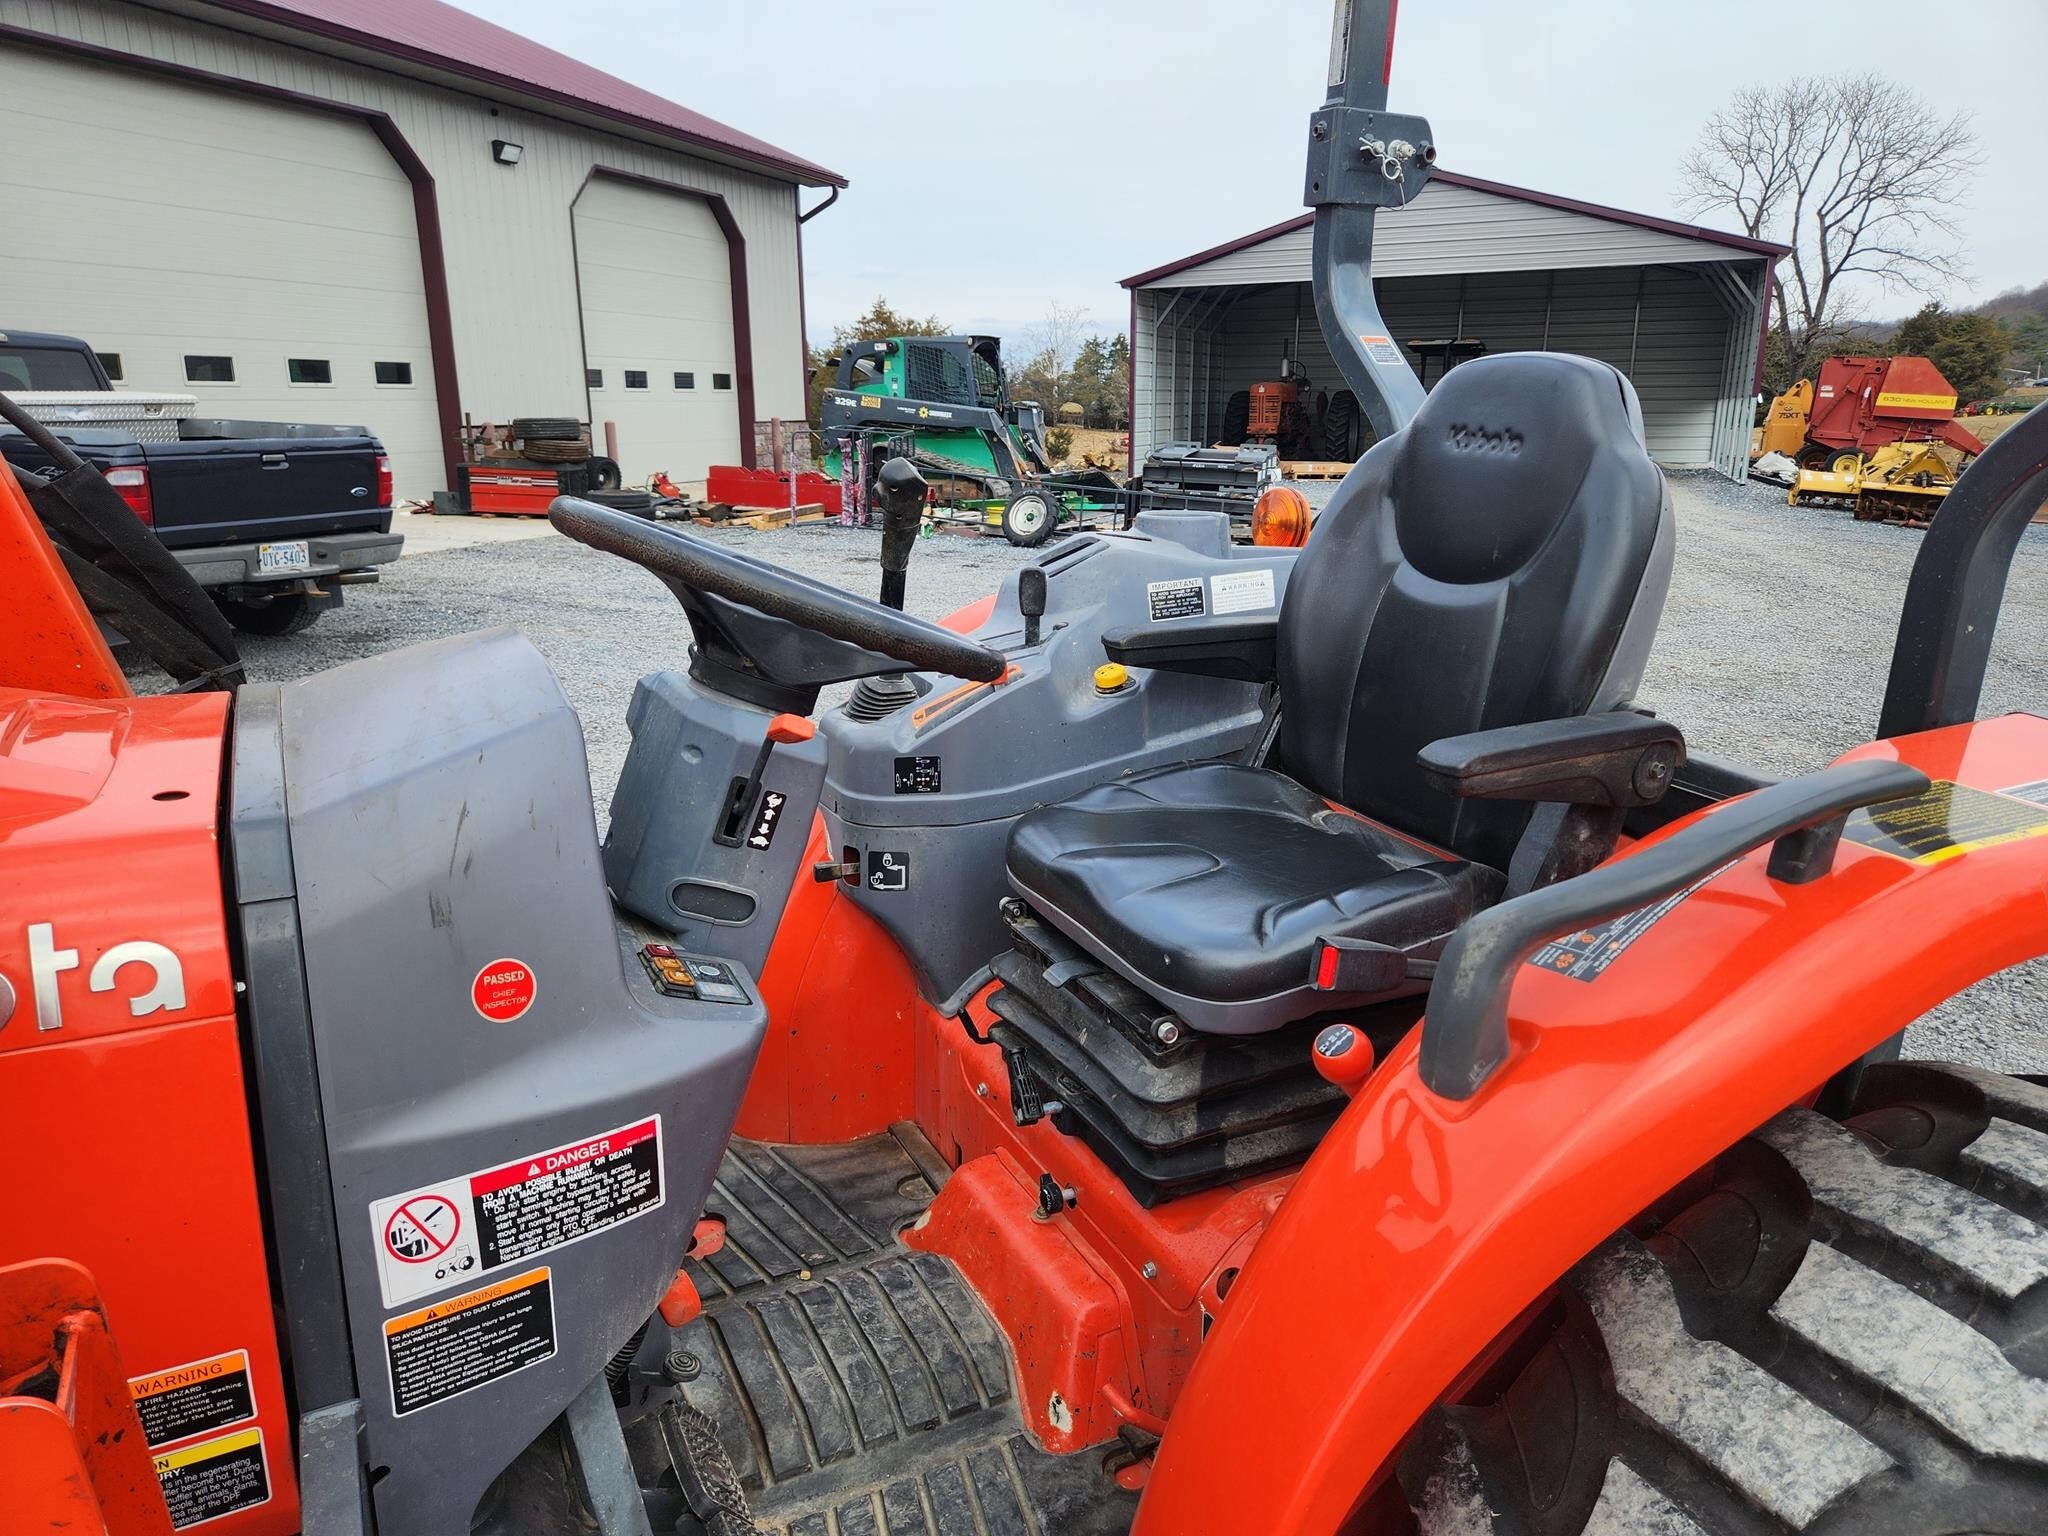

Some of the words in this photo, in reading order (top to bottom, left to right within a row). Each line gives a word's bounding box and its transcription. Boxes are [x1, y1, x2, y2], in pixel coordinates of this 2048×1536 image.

[834, 396, 857, 407] 329E
[1447, 425, 1524, 456] Kubota
[262, 550, 306, 566] UYG-5403
[1152, 580, 1197, 590] IMPORTANT
[484, 971, 525, 986] PASSED
[483, 996, 528, 1010] INSPECTOR
[493, 988, 517, 998] CHIEF
[547, 1140, 608, 1170] DANGER
[482, 1193, 493, 1203] TO
[497, 1184, 520, 1198] AVOID
[526, 1171, 560, 1188] POSSIBLE
[565, 1161, 590, 1175] INJURY
[594, 1156, 604, 1165] OR
[609, 1146, 631, 1160] DEATH
[508, 1200, 518, 1209] not
[523, 1194, 538, 1204] start
[542, 1186, 565, 1198] engine
[581, 1171, 606, 1184] shorting
[611, 1163, 630, 1174] across
[483, 1197, 504, 1210] FROM
[520, 1181, 553, 1198] MACHINE
[558, 1169, 594, 1186] RUNAWAY.
[495, 1211, 517, 1222] starter
[521, 1199, 552, 1213] terminals
[567, 1182, 599, 1198] bypassing
[617, 1169, 635, 1180] safety
[496, 1220, 511, 1230] start
[517, 1211, 540, 1223] switch.
[545, 1200, 573, 1214] Machine
[578, 1194, 591, 1202] may
[595, 1186, 608, 1196] start
[622, 1177, 635, 1187] gear
[639, 1170, 649, 1179] and
[497, 1228, 516, 1238] move
[528, 1215, 550, 1228] normal
[556, 1206, 579, 1218] starting
[584, 1194, 608, 1208] circuitry
[622, 1178, 650, 1193] bypassed.
[498, 1236, 514, 1247] Start
[519, 1228, 542, 1240] engine
[546, 1221, 559, 1230] only
[564, 1214, 578, 1224] from
[582, 1201, 613, 1217] operator's
[617, 1194, 629, 1204] seat
[634, 1187, 645, 1197] with
[500, 1251, 520, 1262] Never
[524, 1243, 538, 1253] start
[542, 1235, 563, 1247] engine
[568, 1229, 579, 1238] while
[584, 1216, 613, 1232] standing
[639, 1196, 658, 1210] ground.
[500, 1235, 542, 1254] transmission
[547, 1229, 558, 1238] and
[563, 1222, 577, 1232] PTO
[581, 1217, 596, 1226] OFF.
[446, 1286, 500, 1313] WARNING
[402, 1328, 422, 1339] AVOID
[424, 1314, 460, 1331] EXPOSURE
[473, 1304, 490, 1314] DUST
[492, 1290, 530, 1307] CONTAINING
[411, 1344, 424, 1352] dust
[439, 1333, 456, 1342] cause
[459, 1325, 479, 1335] serious
[482, 1318, 497, 1327] injury
[517, 1305, 531, 1313] lungs
[392, 1339, 411, 1349] SILICA
[413, 1326, 449, 1342] PARTICLES:
[398, 1355, 414, 1364] under
[417, 1348, 433, 1357] some
[435, 1338, 462, 1351] exposure
[402, 1385, 428, 1399] Personal
[431, 1374, 460, 1388] Protective
[462, 1361, 492, 1376] Equipment
[507, 1350, 518, 1359] dust
[520, 1338, 548, 1353] abatement
[410, 1380, 424, 1389] meet
[426, 1372, 444, 1383] OSHA
[447, 1367, 461, 1375] silica
[508, 1336, 539, 1351] appropriate
[135, 1363, 221, 1394] WARNING
[142, 1403, 168, 1413] and/or
[144, 1396, 163, 1405] FIRE
[167, 1385, 201, 1399] HAZARD
[146, 1410, 167, 1419] there
[180, 1398, 209, 1409] nothing
[146, 1418, 164, 1426] near
[183, 1403, 213, 1415] exhaust
[166, 1418, 187, 1427] under
[207, 1404, 233, 1415] bonnet
[181, 1477, 213, 1492] become
[216, 1472, 230, 1481] hot.
[233, 1463, 259, 1476] During
[200, 1458, 250, 1478] regenerating
[195, 1486, 207, 1496] will
[222, 1478, 239, 1487] very
[242, 1472, 254, 1481] hot
[188, 1504, 205, 1514] near
[208, 1500, 220, 1508] the
[223, 1492, 240, 1503] DPF
